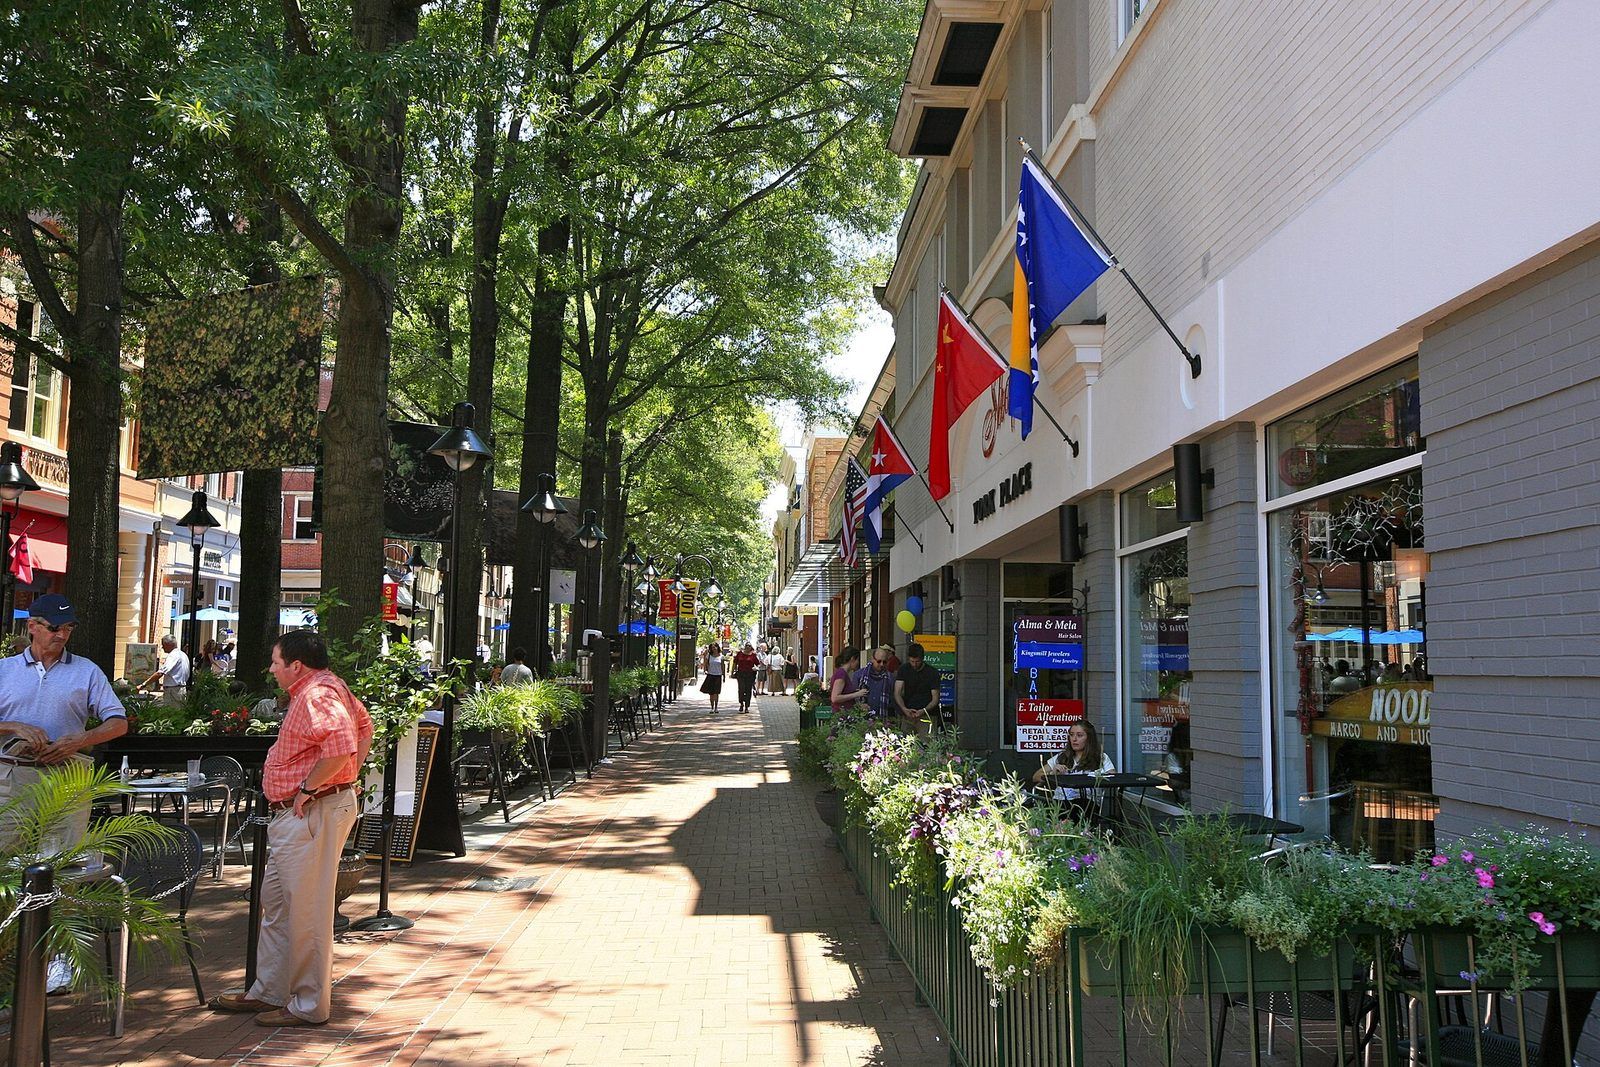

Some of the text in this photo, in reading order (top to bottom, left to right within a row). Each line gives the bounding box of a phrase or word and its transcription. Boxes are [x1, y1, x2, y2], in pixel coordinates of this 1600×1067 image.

[999, 462, 1033, 508] PLACE
[385, 586, 392, 595] 3
[1018, 619, 1077, 630] Alma & Mela
[1021, 650, 1048, 658] Kingsmill
[1018, 702, 1054, 712] E. Tailor
[1036, 712, 1083, 722] Alterations
[1330, 721, 1361, 738] MARCO
[1376, 726, 1398, 742] AND
